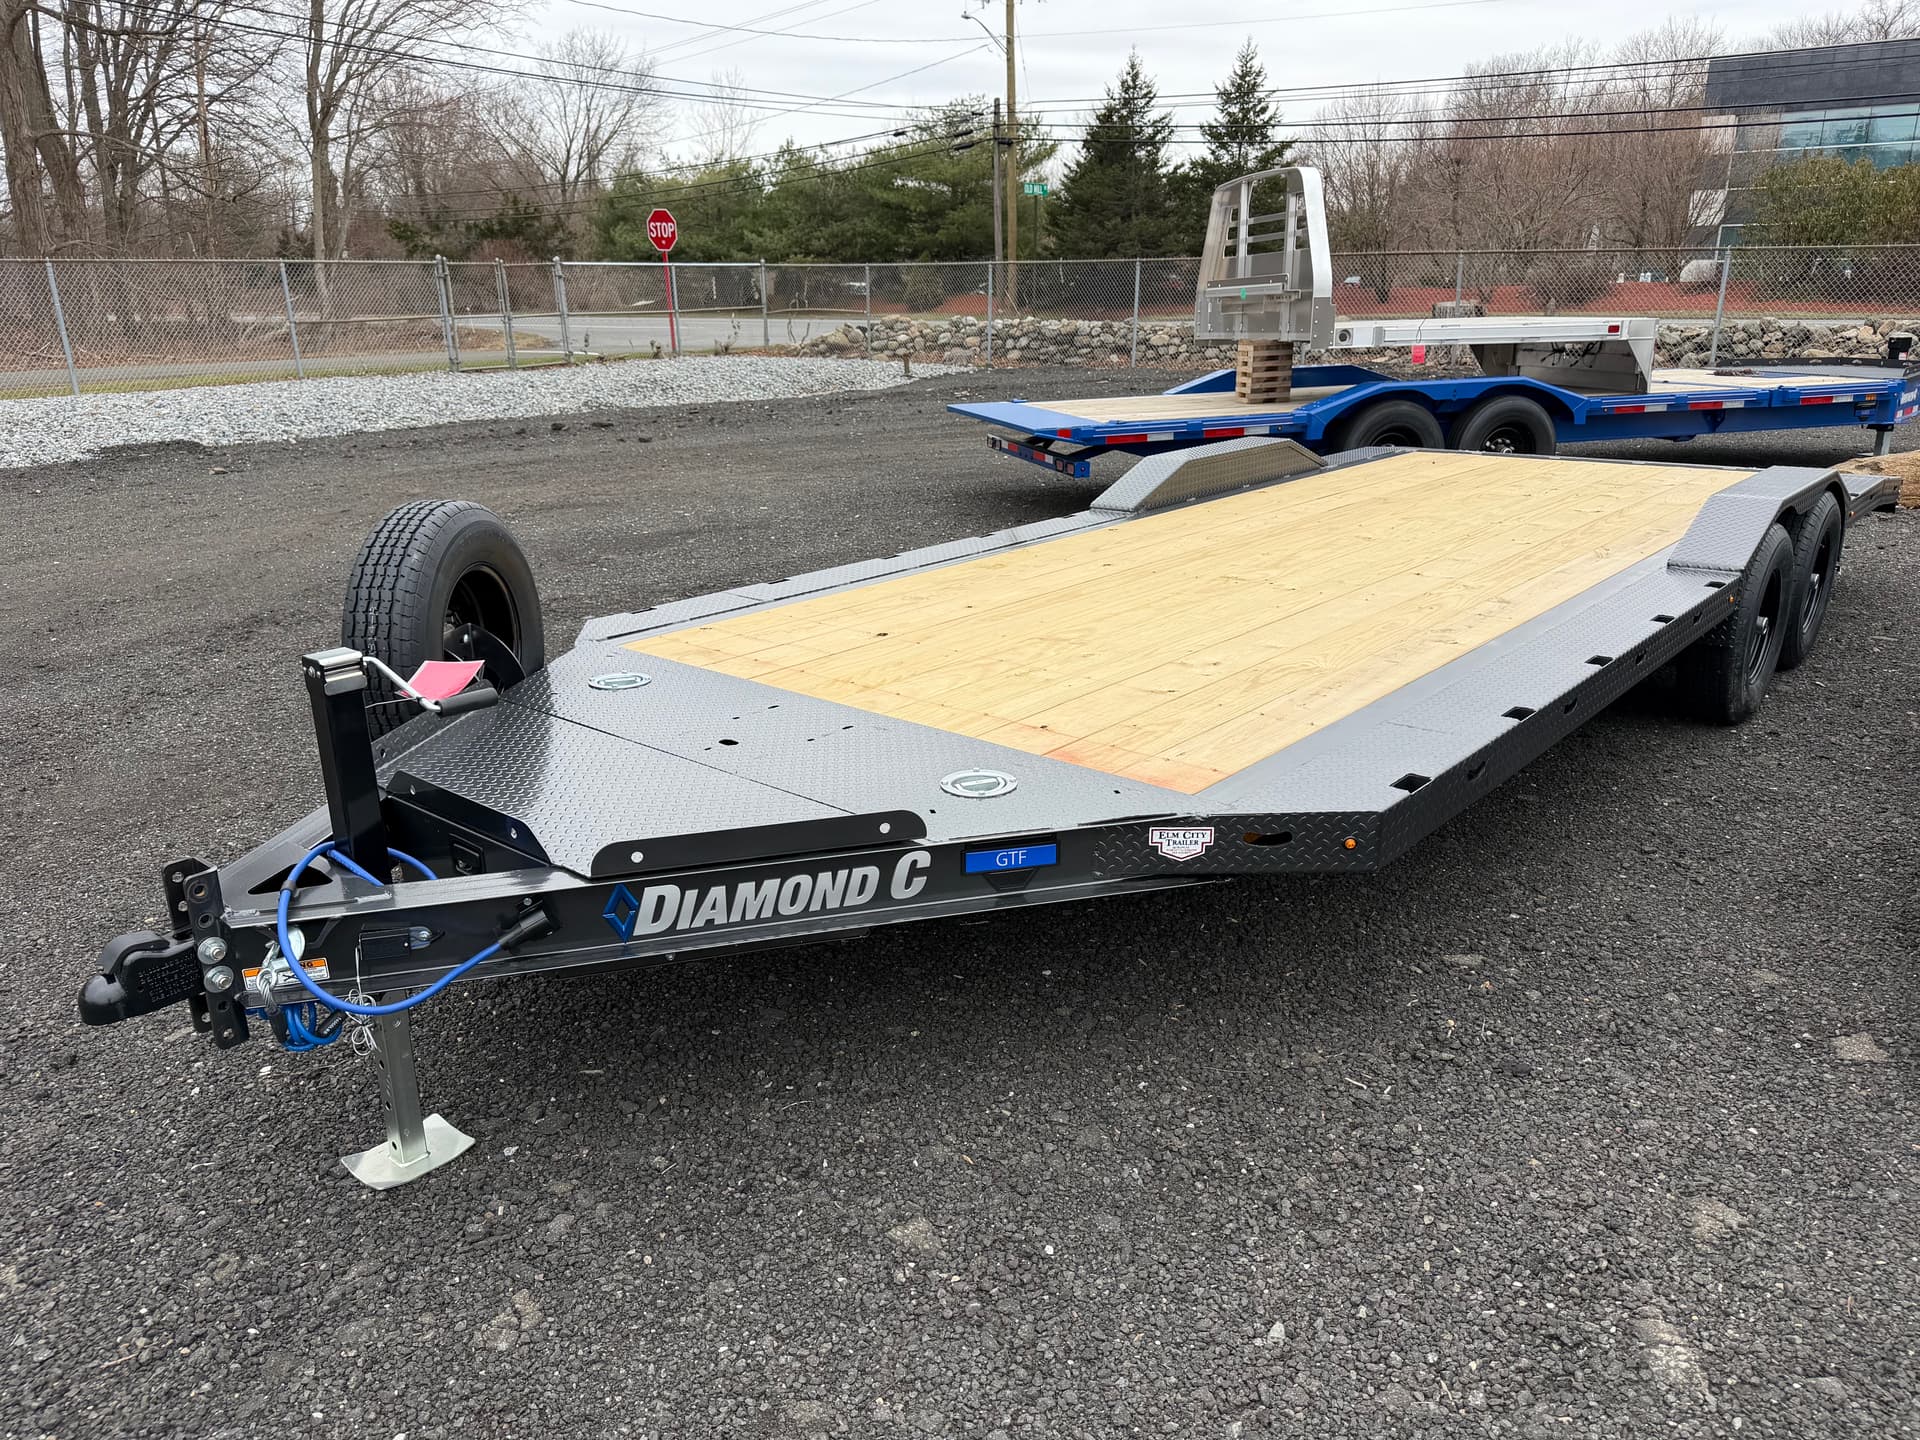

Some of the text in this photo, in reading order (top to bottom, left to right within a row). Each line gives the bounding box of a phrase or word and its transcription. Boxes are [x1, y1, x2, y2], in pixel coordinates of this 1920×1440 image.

[650, 222, 675, 238] STOP
[1159, 831, 1207, 840] ELM CITY
[1166, 839, 1199, 847] TRAILER
[996, 850, 1027, 867] GTF
[632, 849, 931, 937] DIAMOND C
